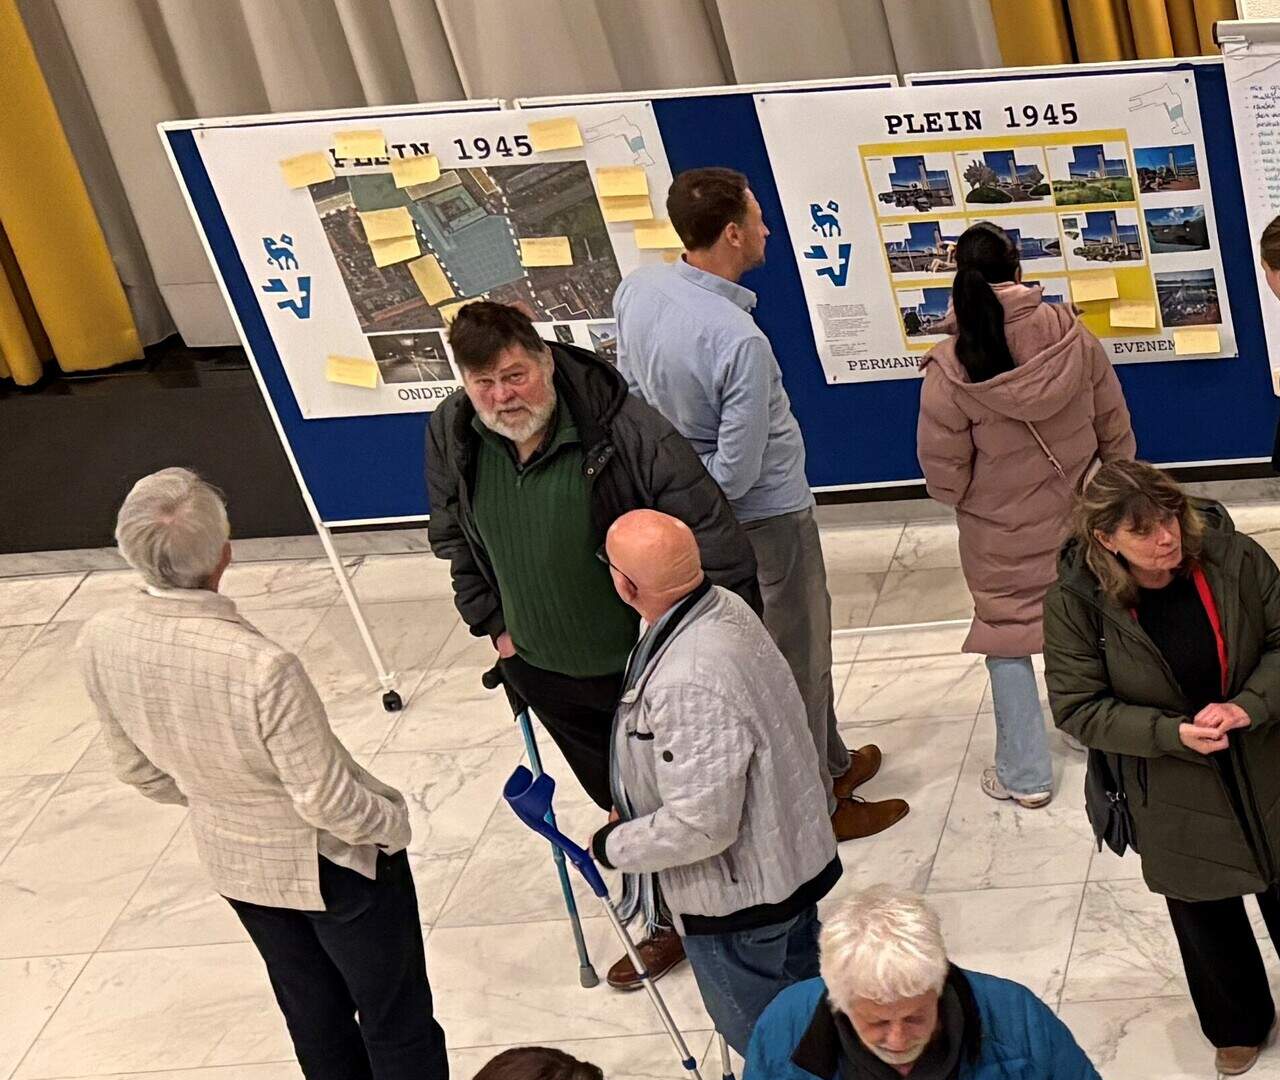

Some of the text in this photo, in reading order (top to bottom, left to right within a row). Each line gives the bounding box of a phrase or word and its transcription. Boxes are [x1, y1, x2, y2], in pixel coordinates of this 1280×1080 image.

[884, 102, 1078, 135] PLEIN 1945
[453, 134, 534, 161] 1945
